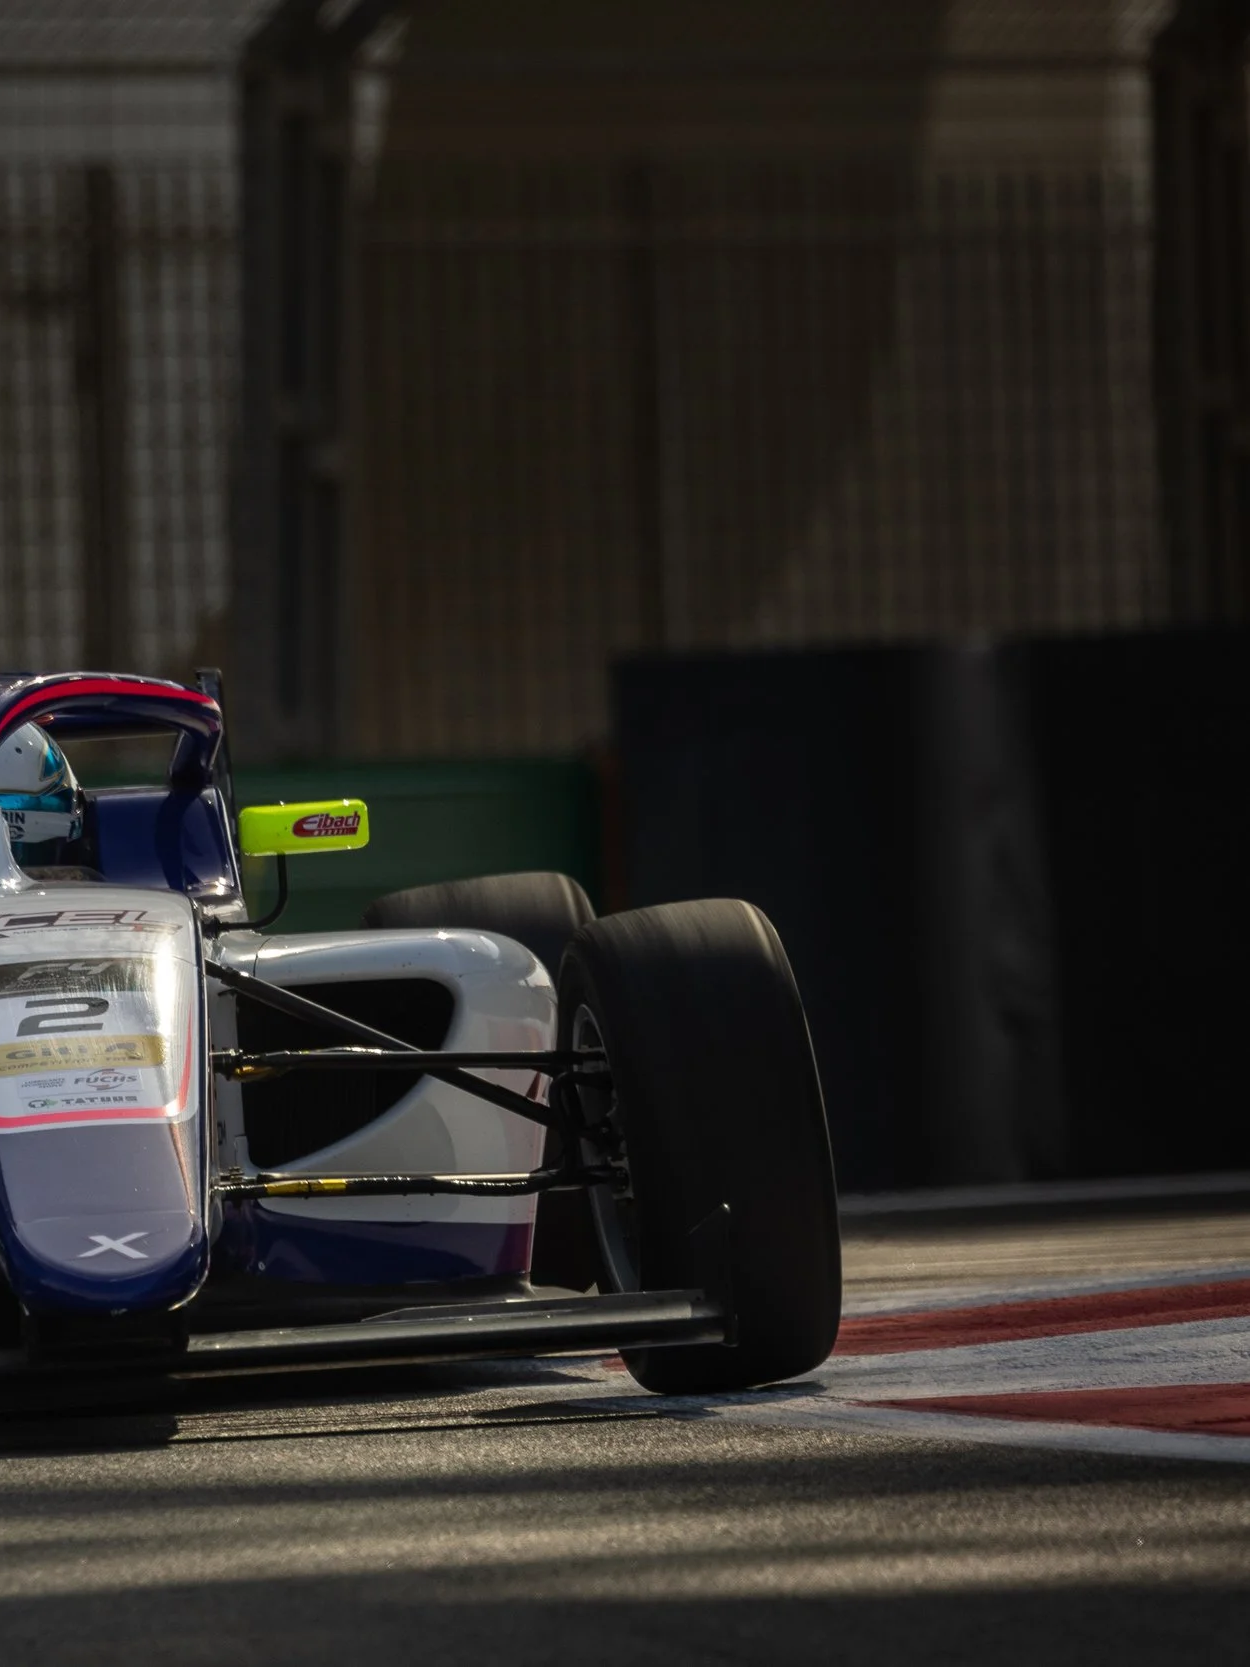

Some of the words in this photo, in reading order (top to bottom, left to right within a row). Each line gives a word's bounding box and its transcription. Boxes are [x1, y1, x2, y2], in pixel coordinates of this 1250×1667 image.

[299, 811, 360, 831] Eibach
[17, 997, 109, 1037] 2
[74, 1075, 137, 1085] FUCHS
